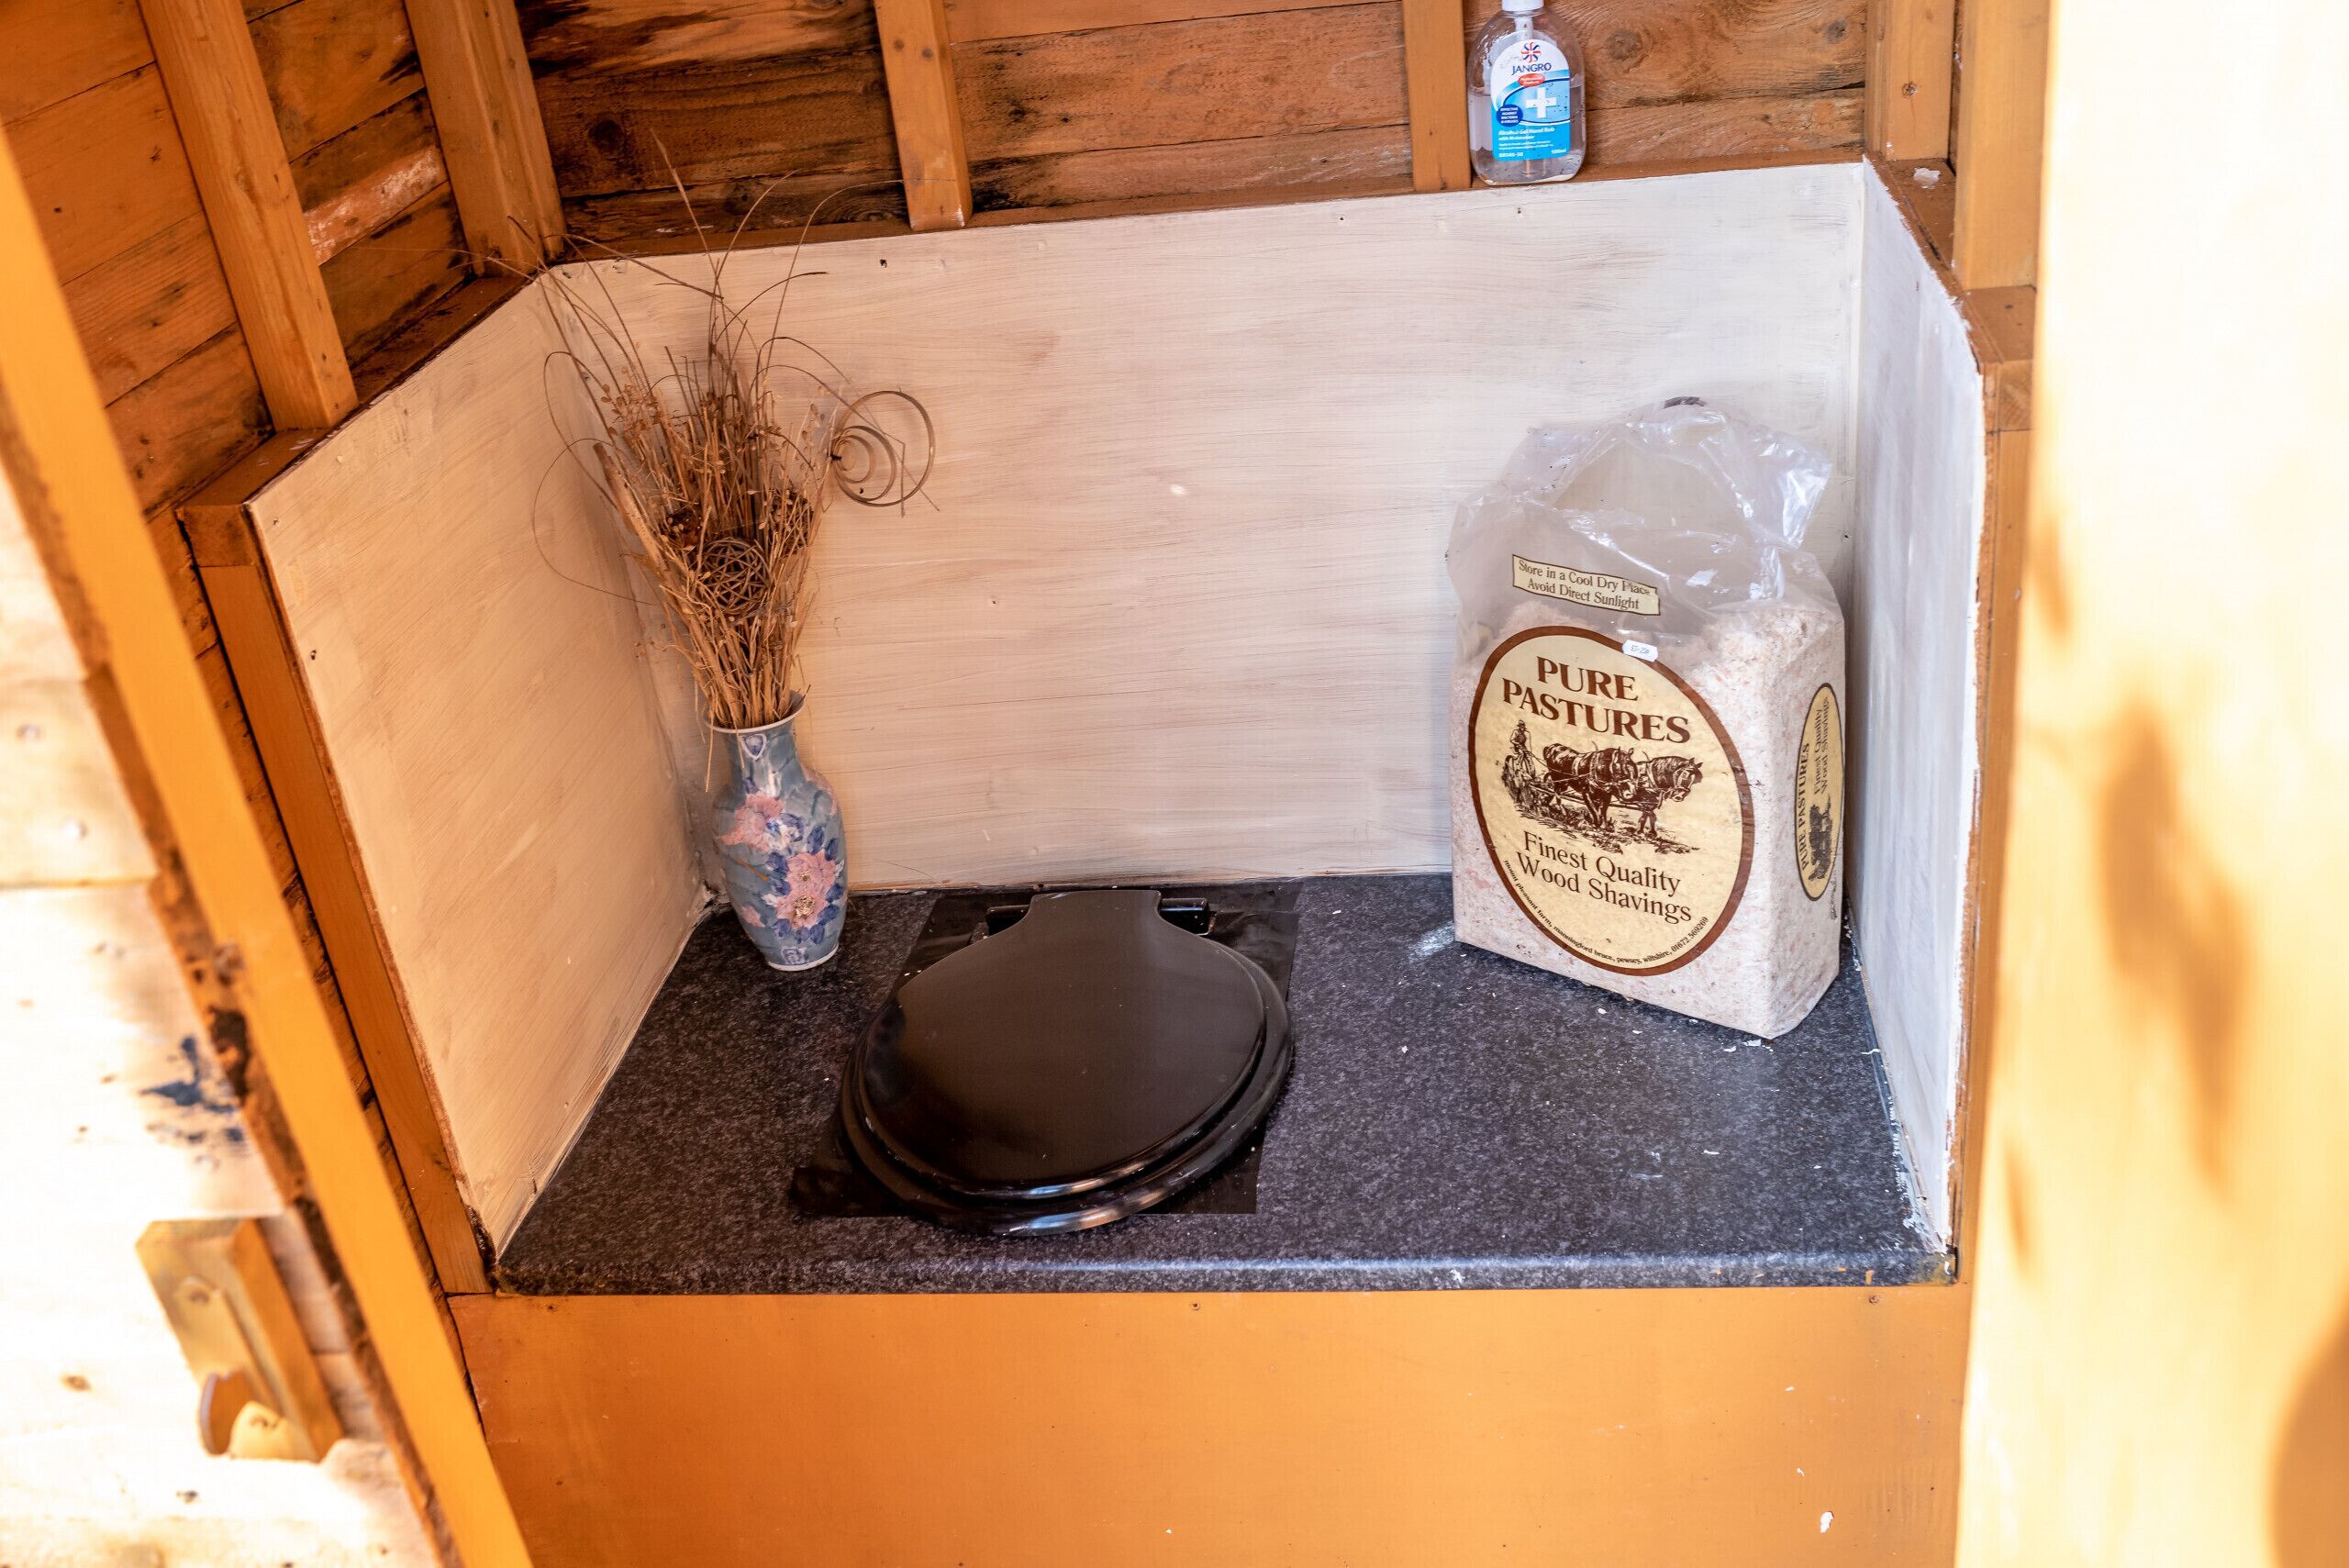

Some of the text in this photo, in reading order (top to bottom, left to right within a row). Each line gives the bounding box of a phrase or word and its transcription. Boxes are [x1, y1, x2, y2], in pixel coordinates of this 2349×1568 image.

[1511, 62, 1552, 75] JANGRO
[1519, 559, 1543, 577] Store
[1546, 566, 1556, 579] in
[1560, 572, 1565, 581] a
[1568, 571, 1593, 586] Cool
[1597, 576, 1619, 593] Dry
[1528, 578, 1640, 611] Avoid Direct Sunlight
[1502, 678, 1691, 744] PASTURES
[1536, 656, 1639, 702] PURE
[1798, 742, 1810, 871] PURE PASTURES
[1504, 860, 1519, 882] mount
[1516, 883, 1538, 910] pleasant
[1537, 909, 1553, 928] farm,
[1516, 851, 1692, 925] Wood Shavings
[1522, 830, 1681, 898] Finest Quality
